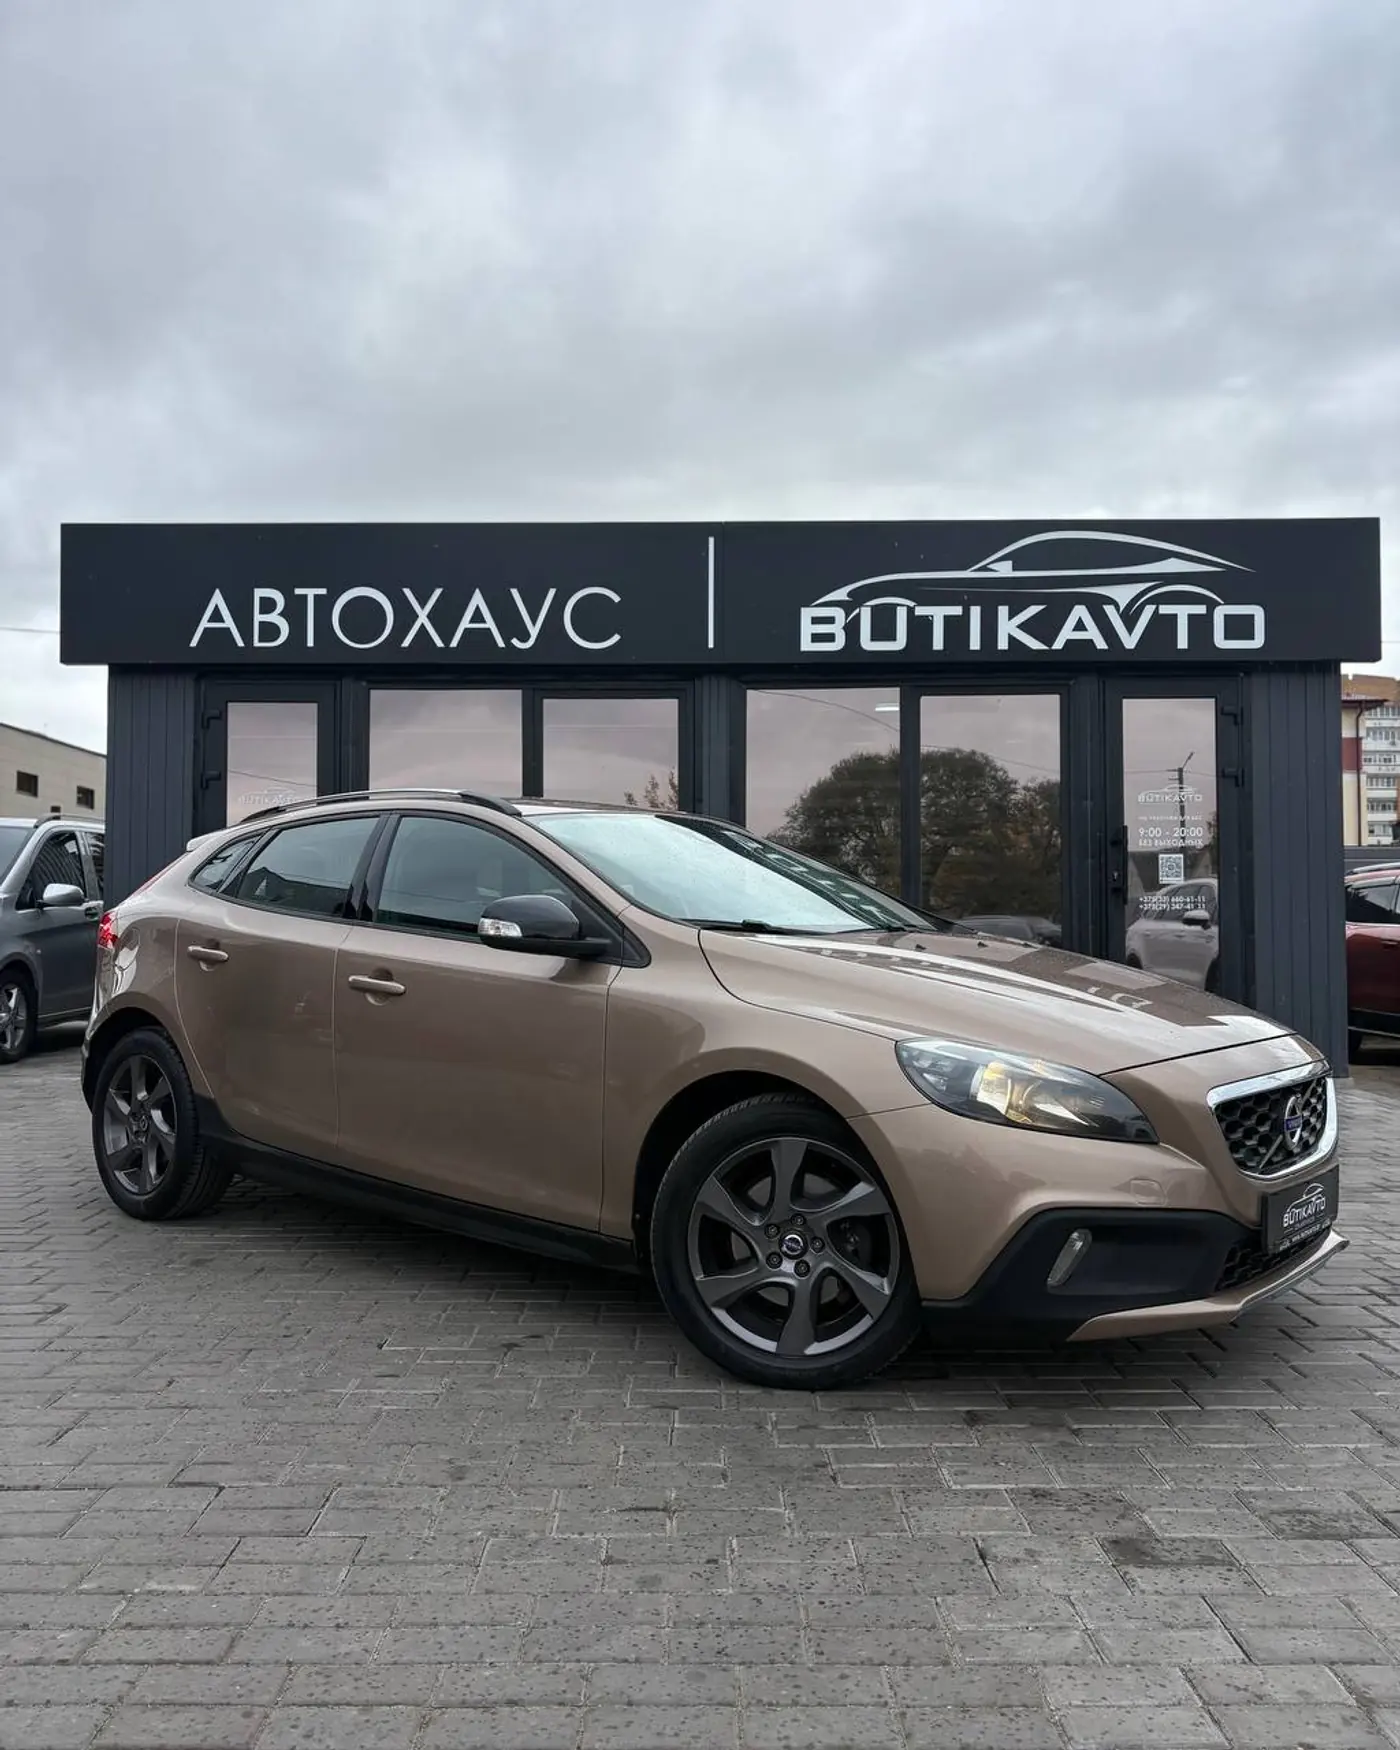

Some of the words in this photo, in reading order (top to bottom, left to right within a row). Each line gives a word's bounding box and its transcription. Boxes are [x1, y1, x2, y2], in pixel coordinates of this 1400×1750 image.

[190, 587, 621, 649] АВТОХАУС
[801, 604, 1264, 651] BUTIKAVTO
[1137, 794, 1203, 802] BUTIKAVTO
[1138, 827, 1162, 837] 9:00
[1173, 827, 1203, 837] 20:00
[1283, 1197, 1326, 1228] BUTIKAVTO
